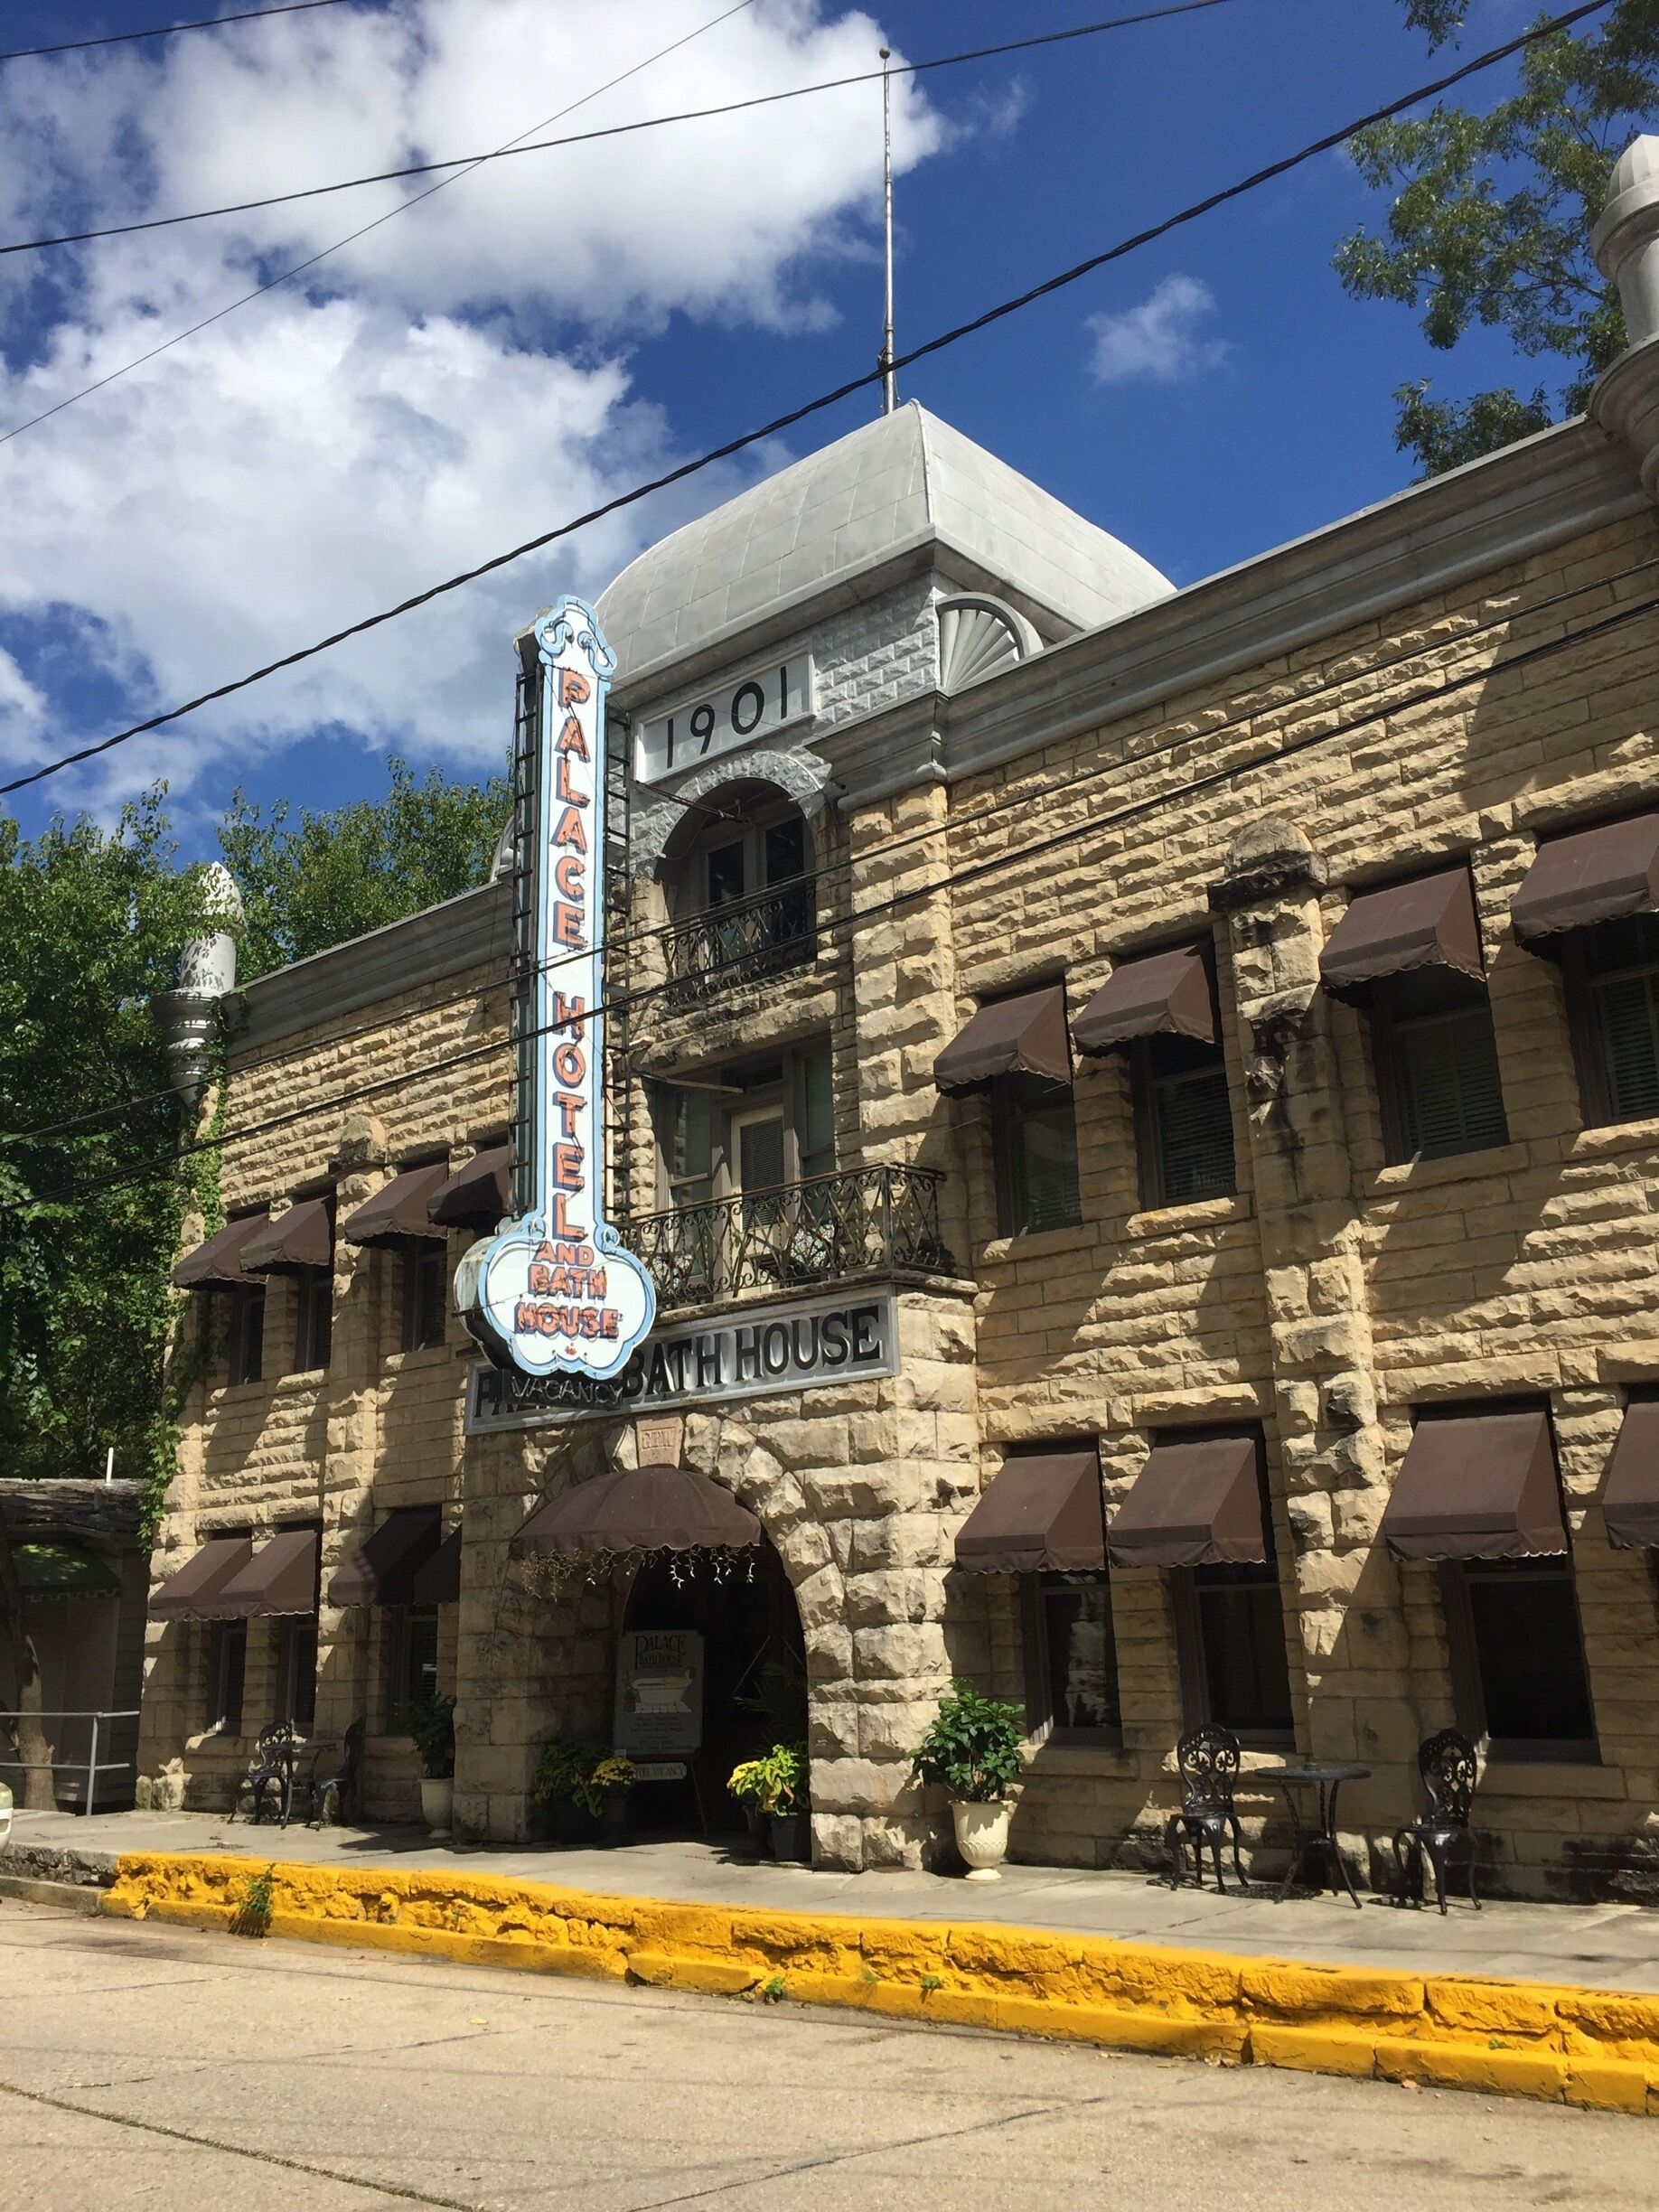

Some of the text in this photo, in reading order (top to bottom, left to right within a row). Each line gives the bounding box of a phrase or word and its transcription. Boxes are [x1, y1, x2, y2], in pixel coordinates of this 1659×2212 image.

[666, 665, 787, 769] 1901
[550, 667, 591, 1242] PALACE HOTEL
[532, 1241, 595, 1265] AND
[528, 1264, 607, 1299] BATH
[514, 1301, 620, 1338] HOUSE
[623, 1333, 722, 1398] BATH
[735, 1305, 883, 1382] HOUSE
[511, 1375, 624, 1405] VACANCY
